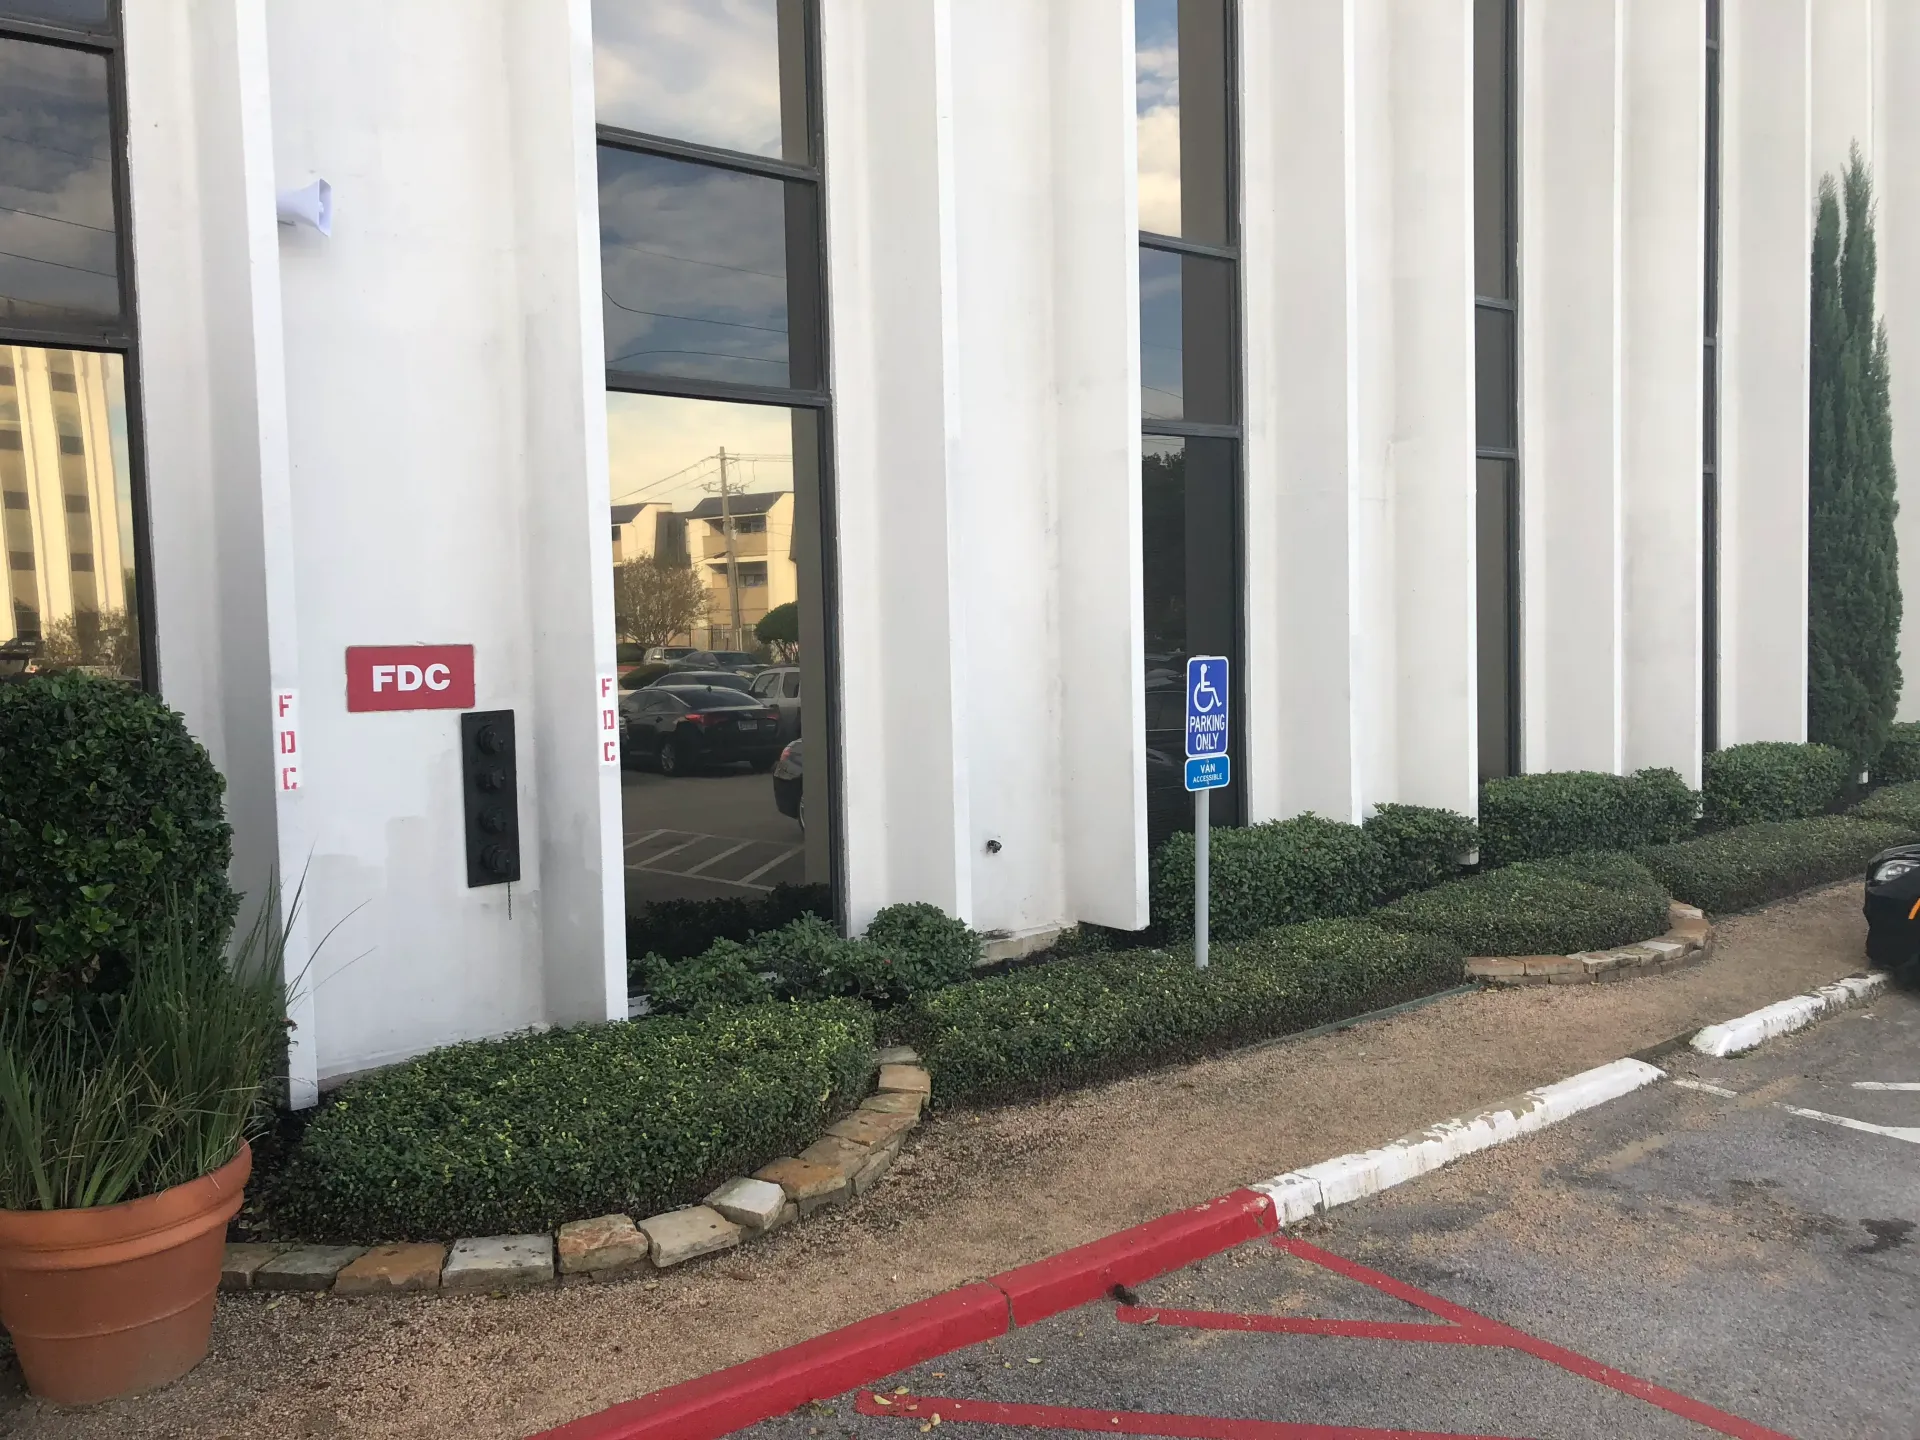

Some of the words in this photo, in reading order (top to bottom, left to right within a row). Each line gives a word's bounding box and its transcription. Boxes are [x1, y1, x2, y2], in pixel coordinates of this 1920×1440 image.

[372, 663, 450, 692] FDC
[1190, 714, 1225, 733] PARKING
[1196, 732, 1218, 751] ONLY
[1200, 763, 1215, 773] VAN
[1193, 773, 1222, 783] ACCESSIBLE
